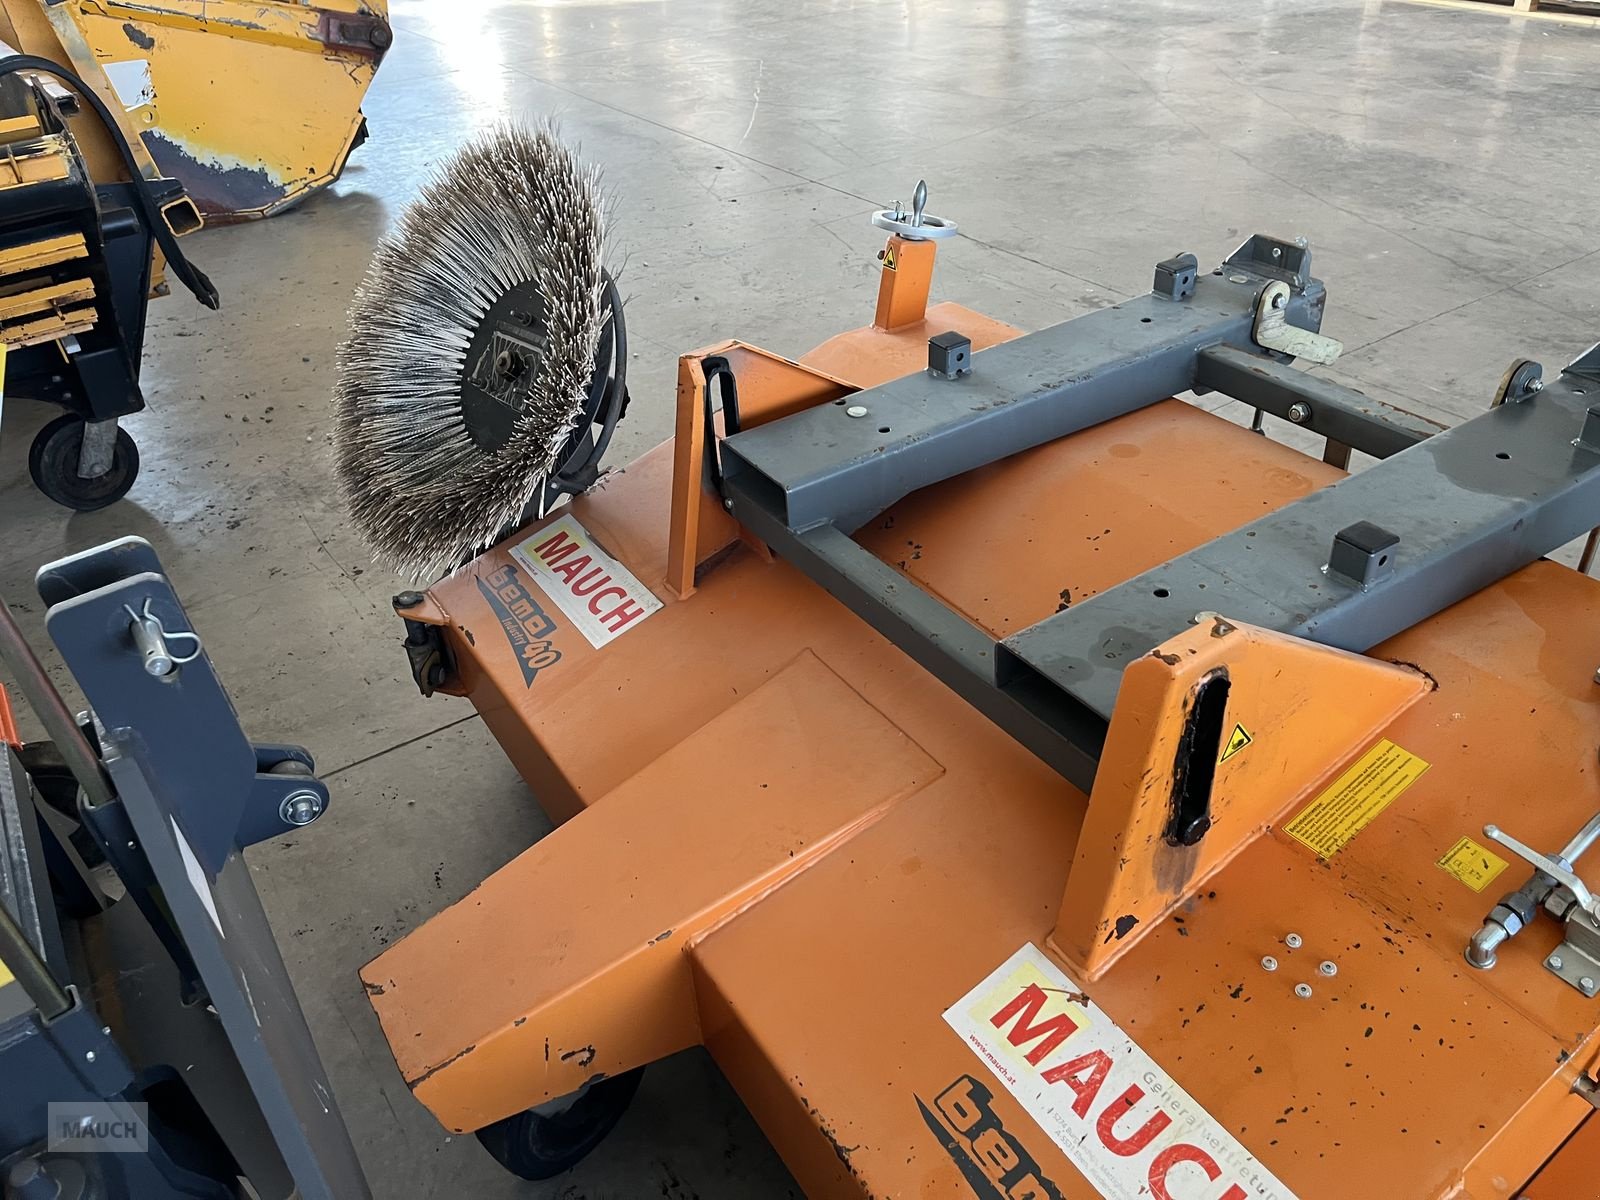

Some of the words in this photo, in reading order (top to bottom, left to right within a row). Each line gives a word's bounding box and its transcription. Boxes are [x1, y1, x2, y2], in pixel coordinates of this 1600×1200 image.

[534, 530, 645, 634] MAUCH
[522, 641, 562, 669] 40
[969, 1034, 1016, 1085] www.mauch.at
[989, 982, 1249, 1200] MAUC
